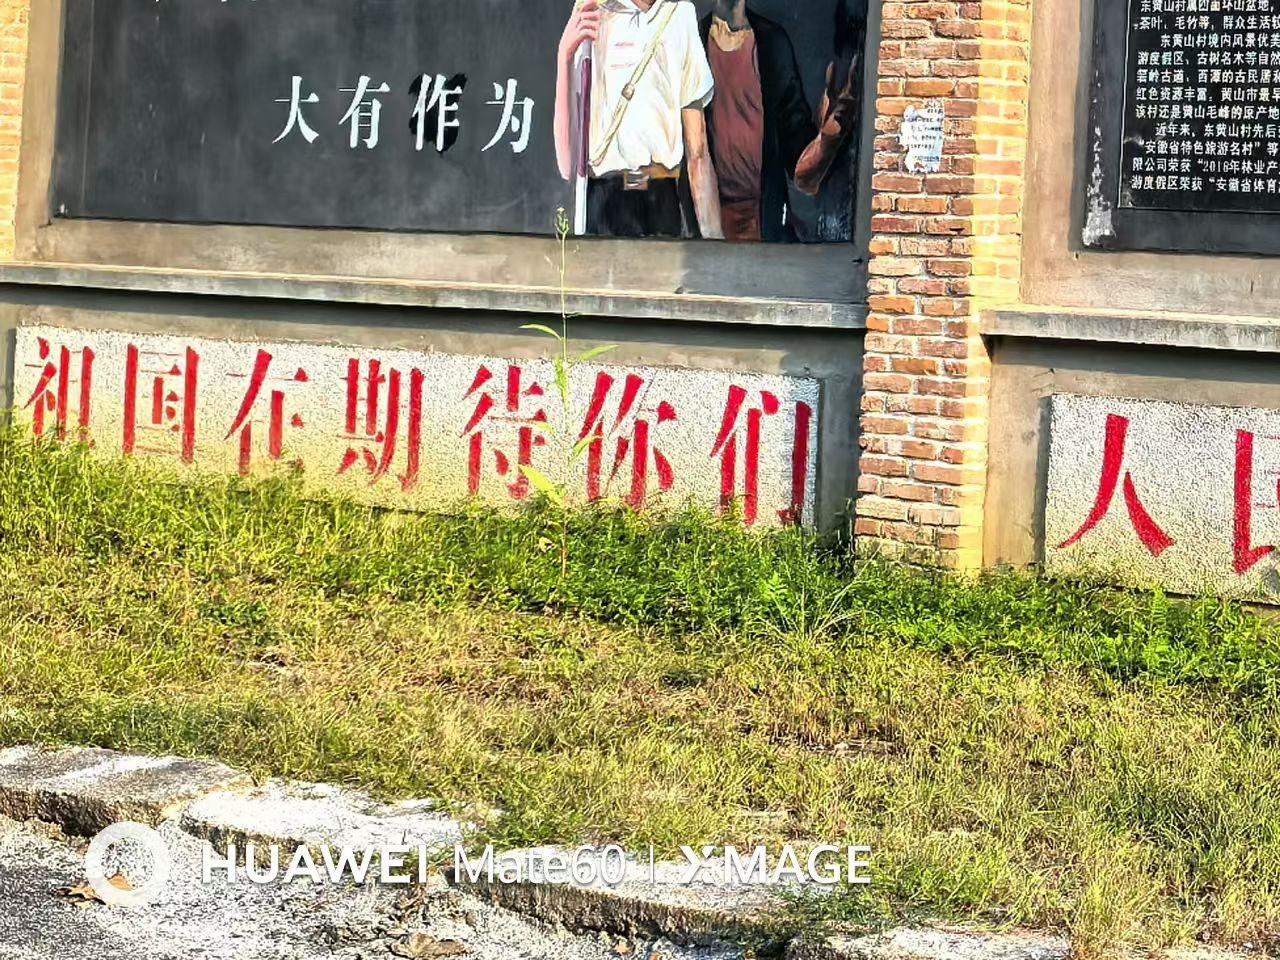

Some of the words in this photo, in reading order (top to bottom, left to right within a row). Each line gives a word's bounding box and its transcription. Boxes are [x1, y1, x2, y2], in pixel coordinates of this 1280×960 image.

[272, 74, 534, 153] 大有作为
[24, 336, 812, 526] 祖国在期待你们
